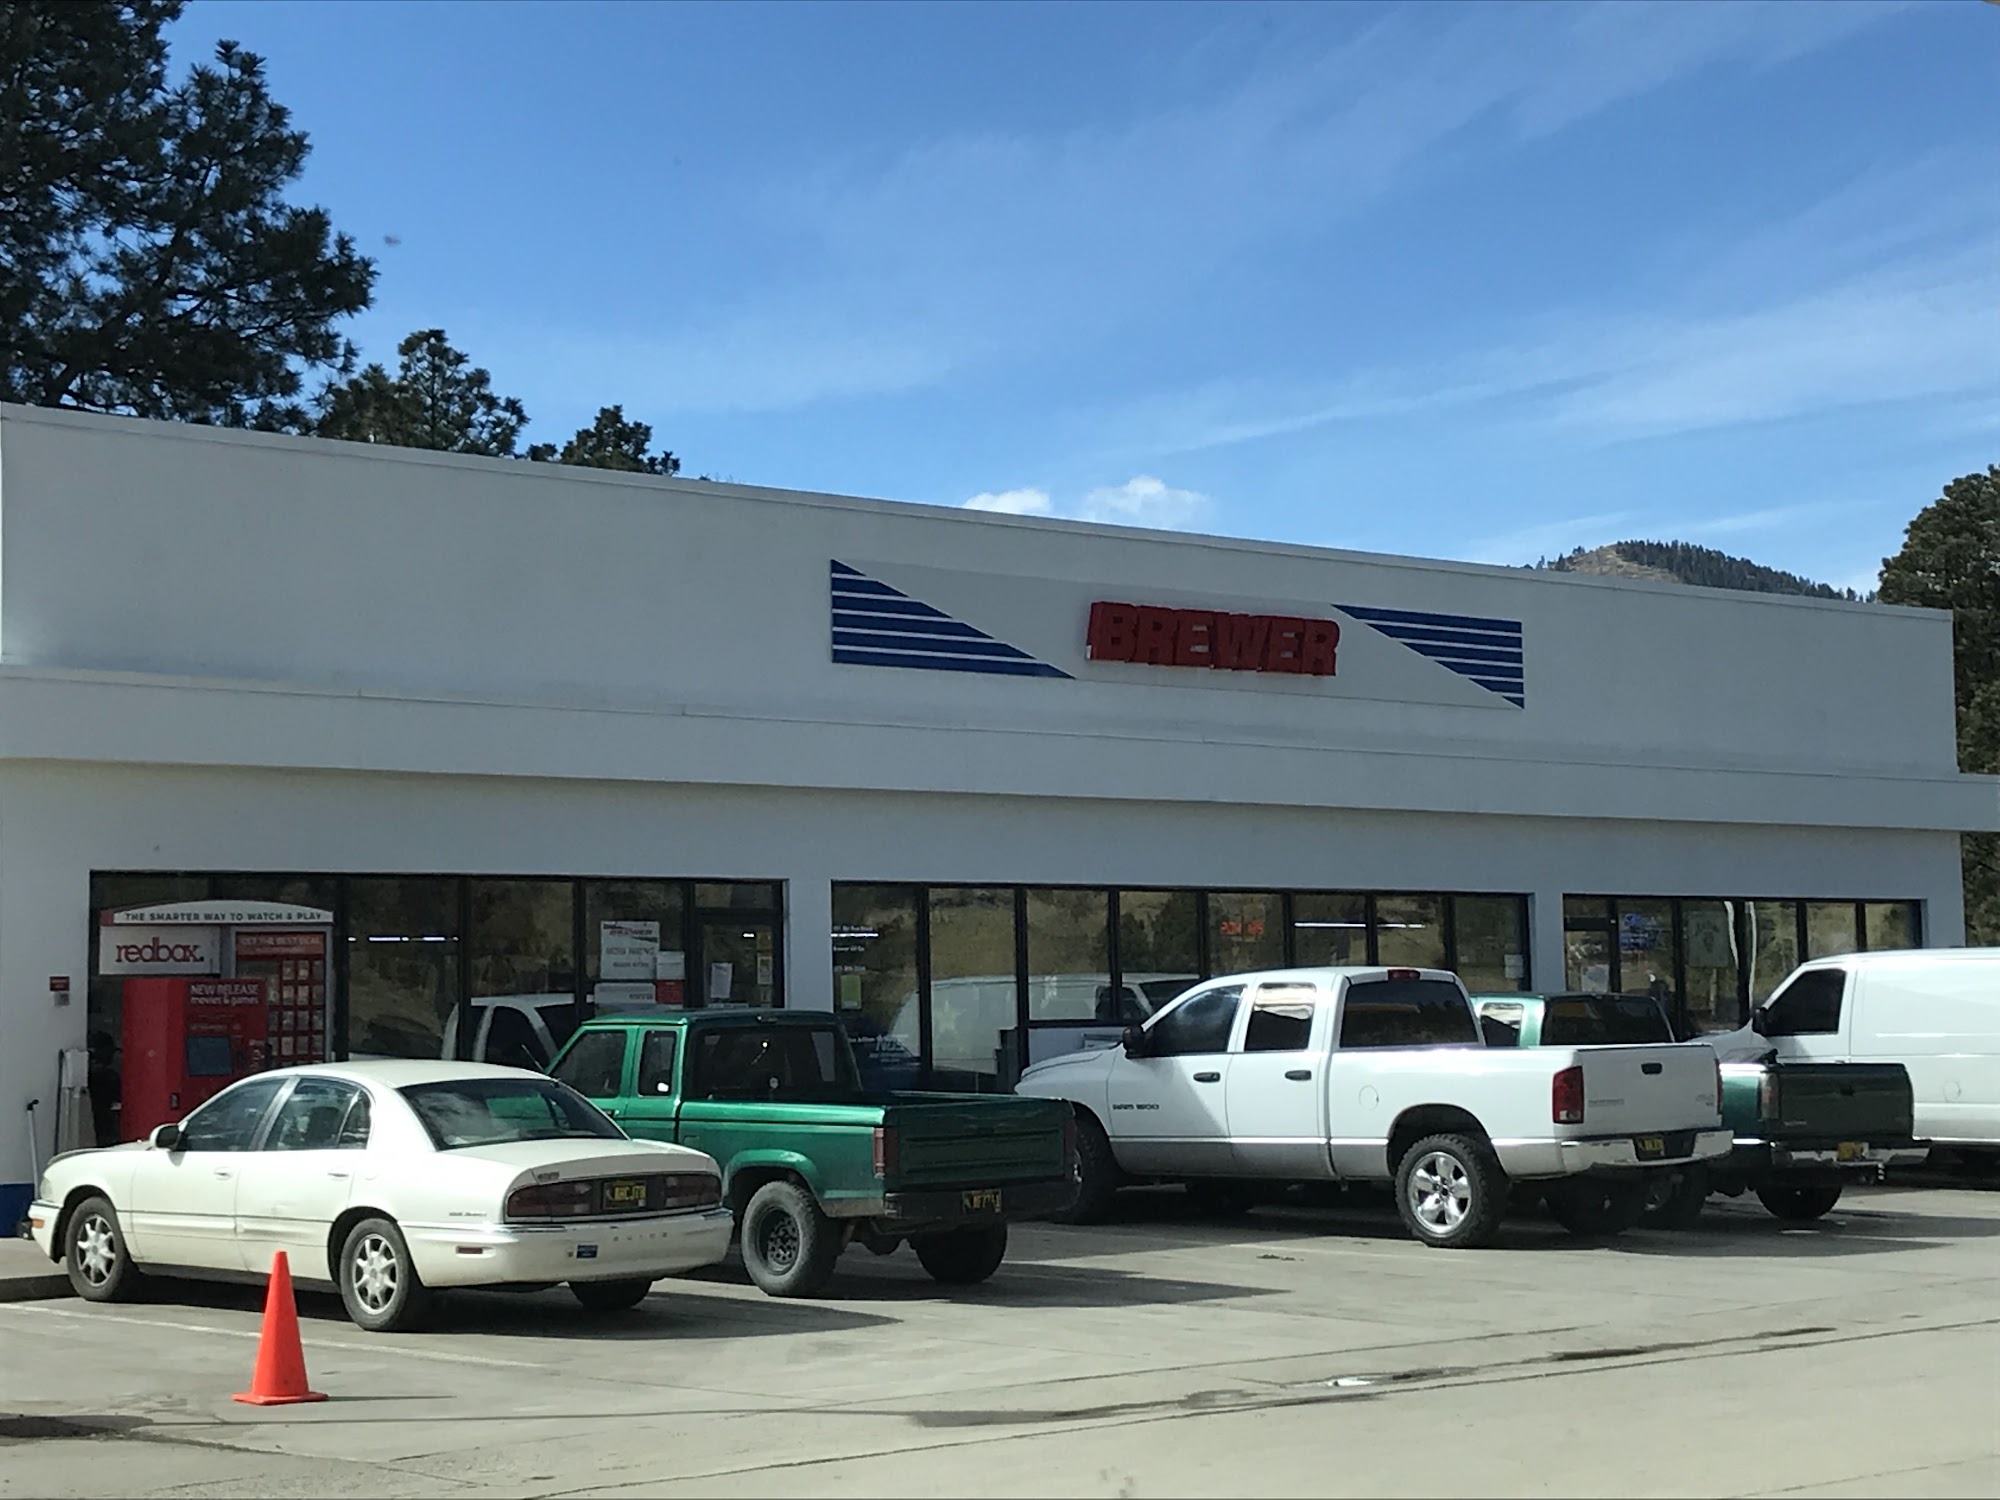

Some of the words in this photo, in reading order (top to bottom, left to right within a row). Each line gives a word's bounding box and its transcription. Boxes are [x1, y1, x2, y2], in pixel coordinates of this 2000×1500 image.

[1087, 601, 1340, 676] BREWER
[125, 912, 145, 921] THE
[149, 912, 200, 921] SMARTER
[204, 912, 226, 921] WAY
[231, 912, 243, 921] TO
[248, 912, 284, 921] WATCH
[297, 912, 322, 921] PLAY
[190, 984, 215, 995] NEW
[217, 984, 259, 995] RELEASE
